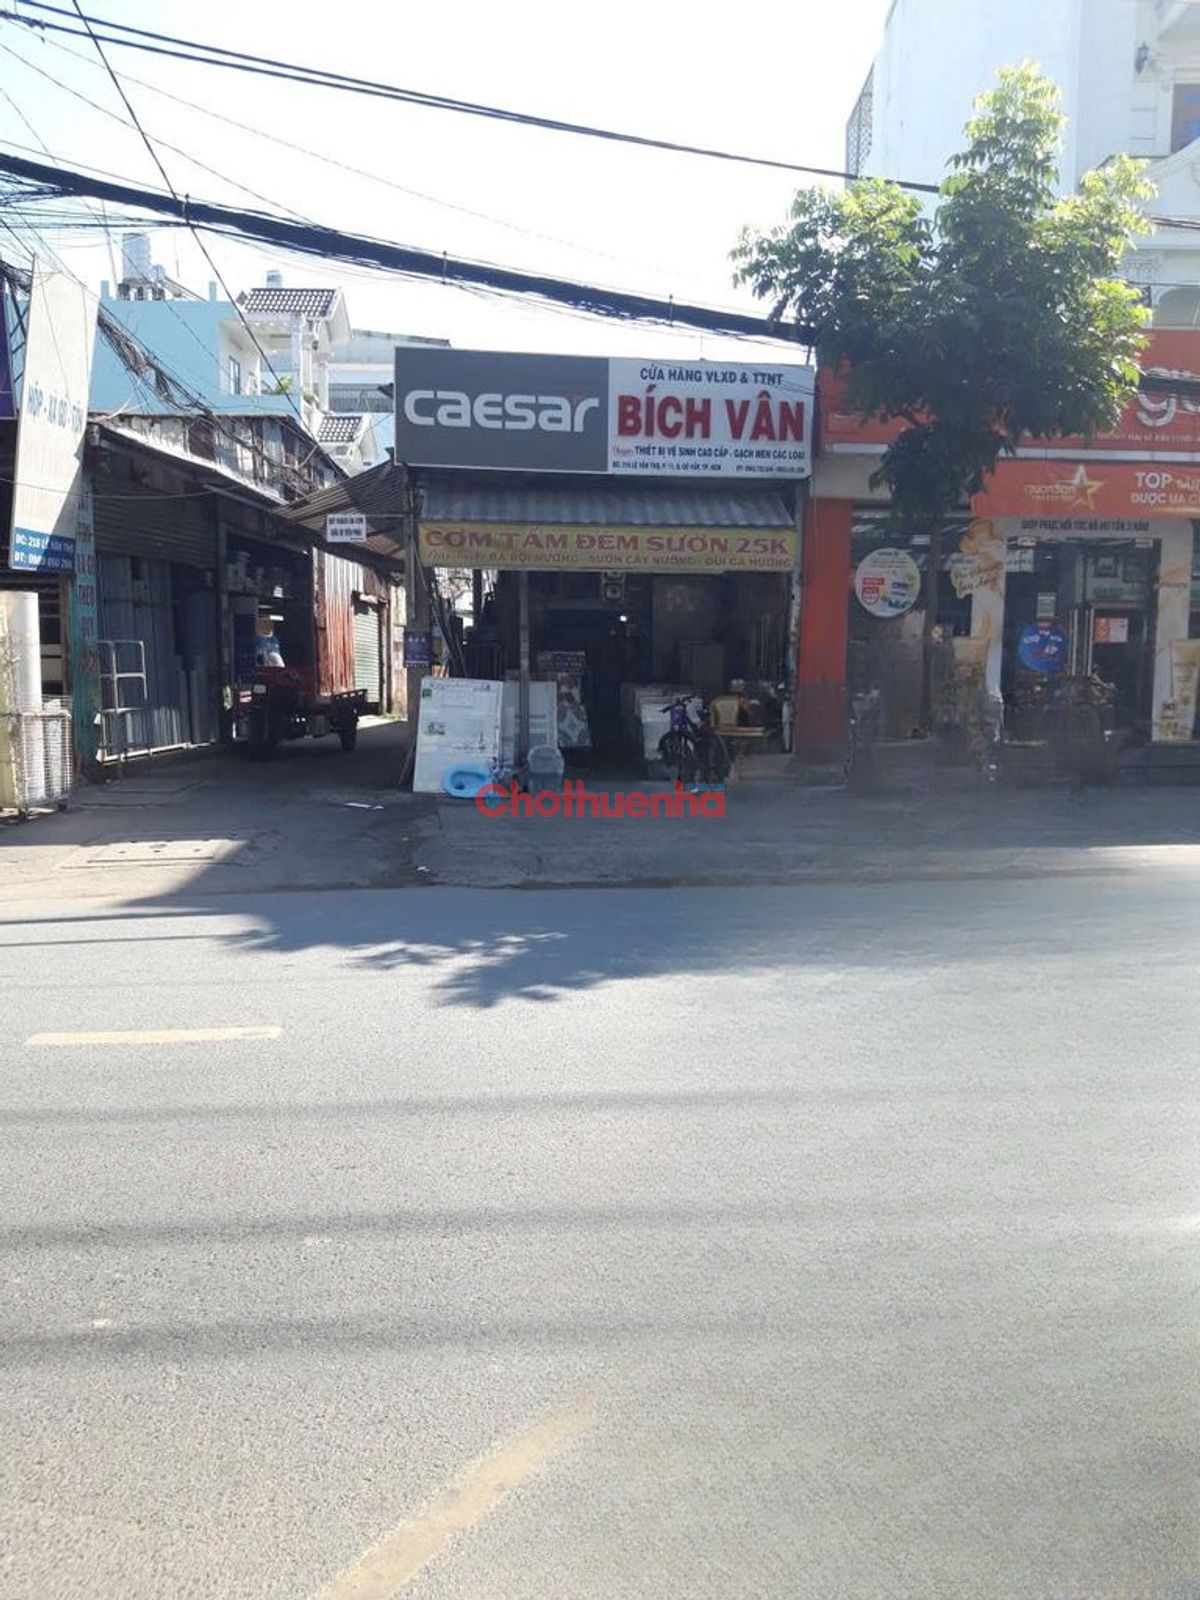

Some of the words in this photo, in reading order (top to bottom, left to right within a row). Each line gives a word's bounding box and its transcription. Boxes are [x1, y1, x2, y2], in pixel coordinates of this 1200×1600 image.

[640, 363, 665, 381] CỬA
[668, 366, 702, 383] HÀNG
[706, 371, 737, 384] VLXD
[740, 372, 748, 384] &
[752, 373, 784, 386] TTNT
[404, 389, 600, 433] caesar
[617, 384, 712, 439] BÍCH
[725, 390, 805, 442] VÂN
[1133, 472, 1173, 489] TOP
[425, 527, 492, 548] CƠM
[736, 538, 789, 554] 25K
